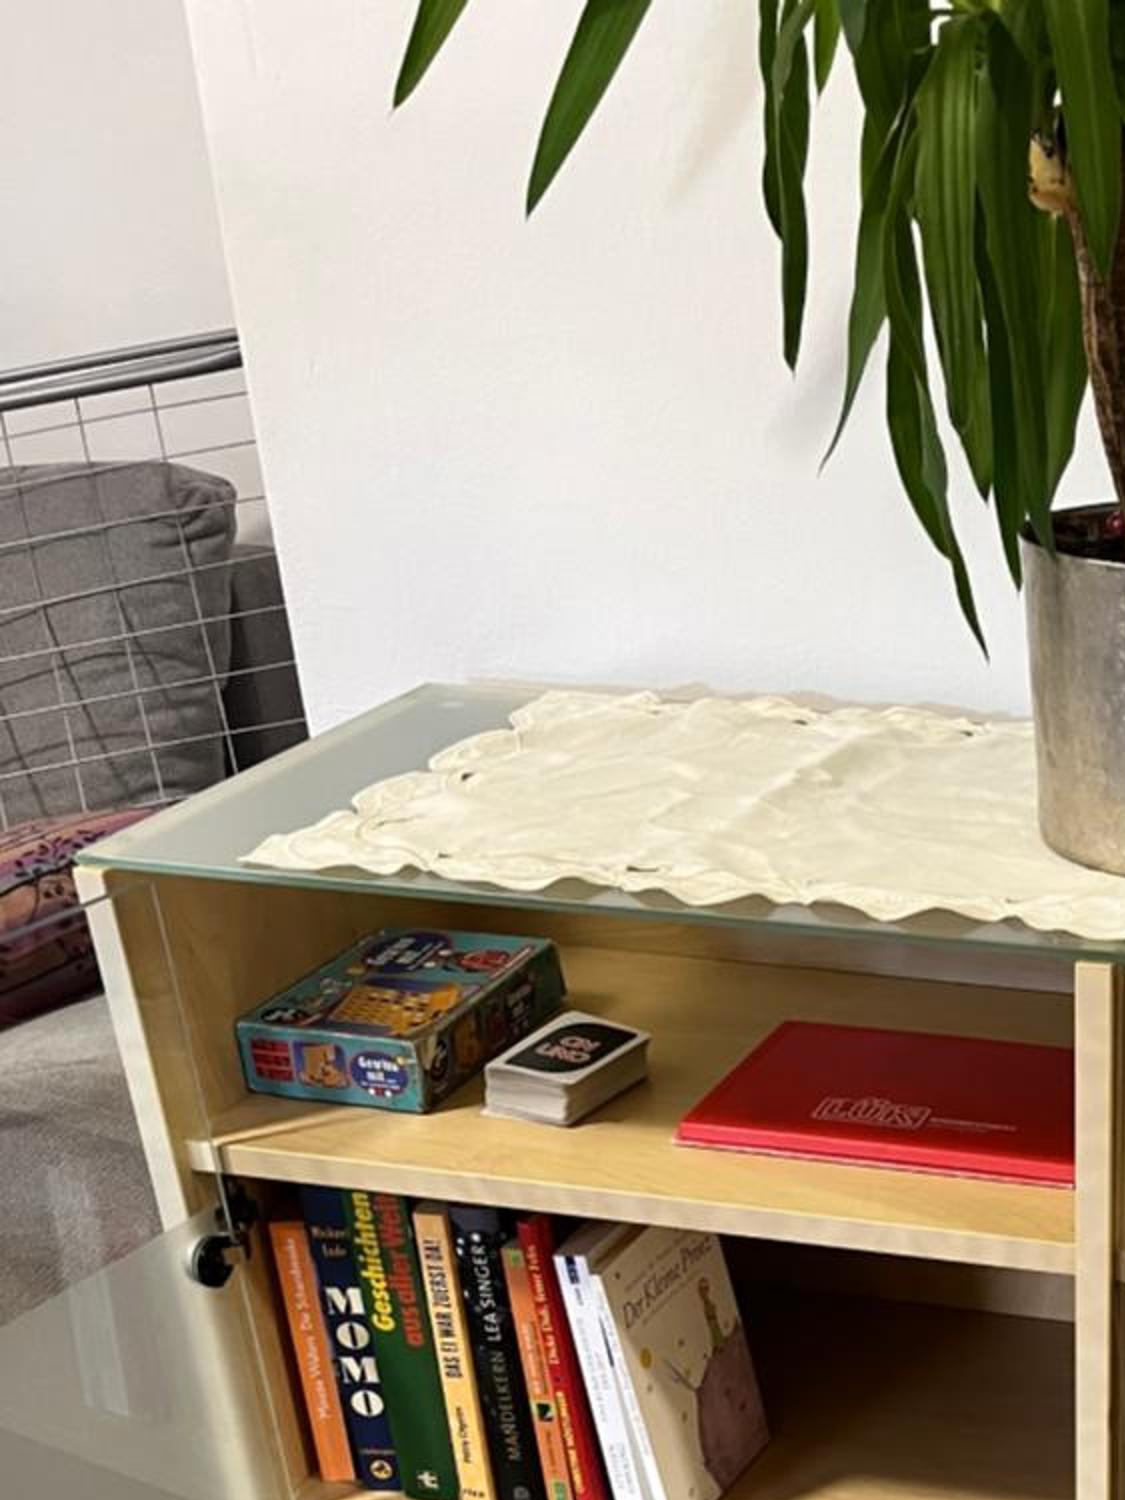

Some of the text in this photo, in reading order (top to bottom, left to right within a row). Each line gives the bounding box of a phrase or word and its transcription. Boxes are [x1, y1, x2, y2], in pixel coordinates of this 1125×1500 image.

[353, 1191, 396, 1332] Geschichten
[421, 1238, 463, 1378] DAS EI WAR ZUERST DA!
[475, 1245, 521, 1460] MANDELKERN LEA SINGER
